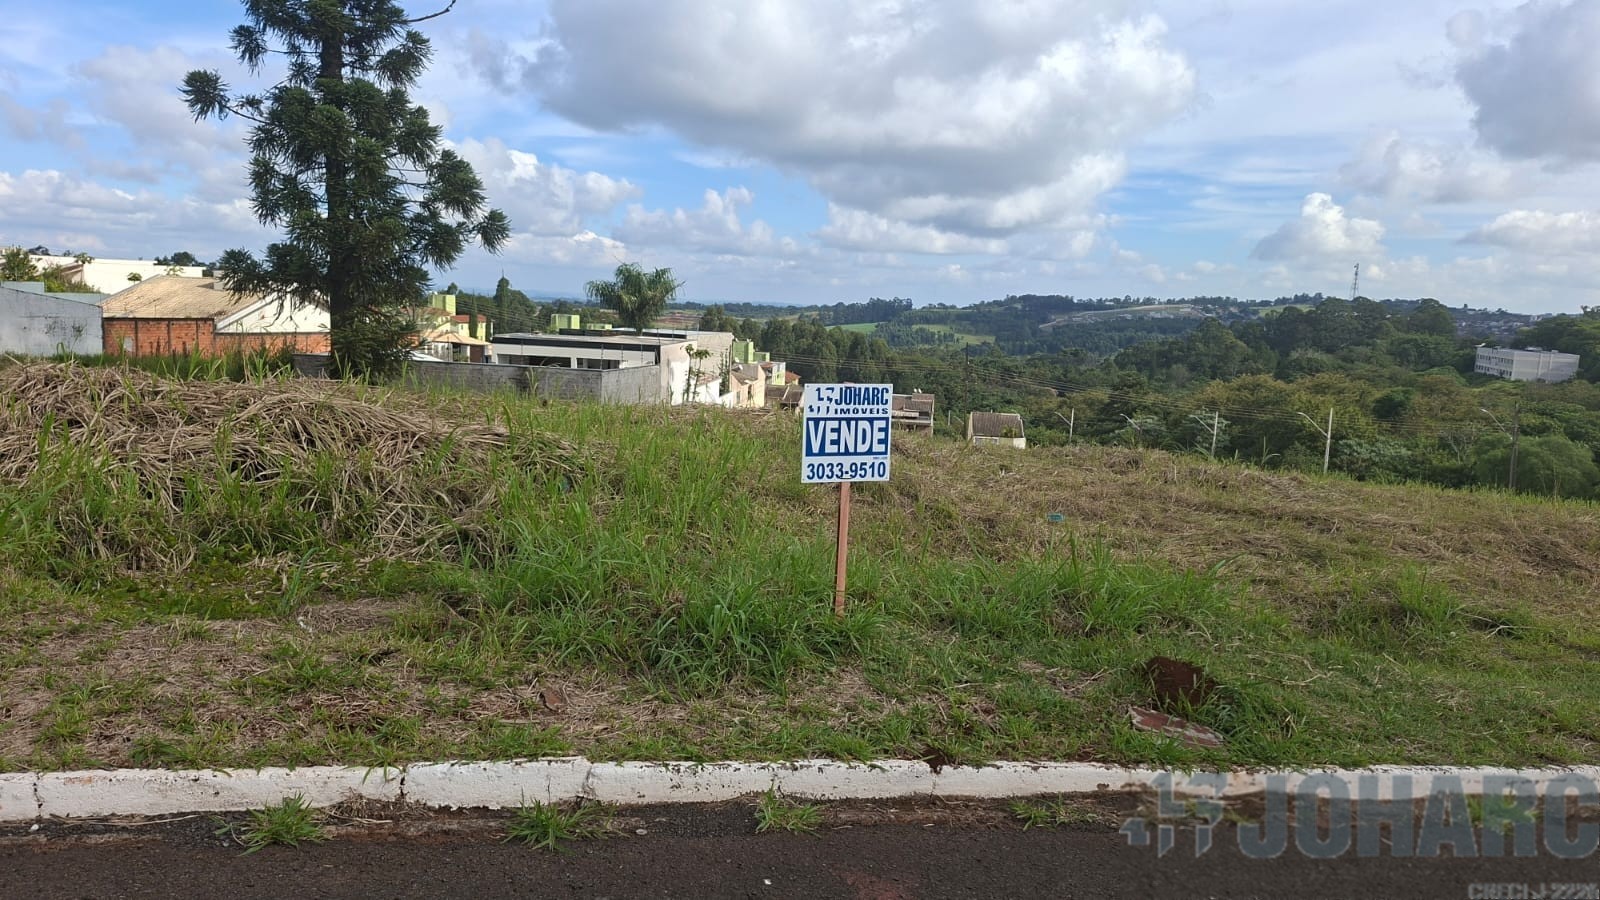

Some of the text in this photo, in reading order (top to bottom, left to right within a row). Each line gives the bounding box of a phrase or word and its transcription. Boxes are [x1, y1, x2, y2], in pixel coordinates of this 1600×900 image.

[835, 387, 889, 406] JOHARC
[808, 420, 886, 453] VENDE
[806, 461, 887, 480] 3033-9510
